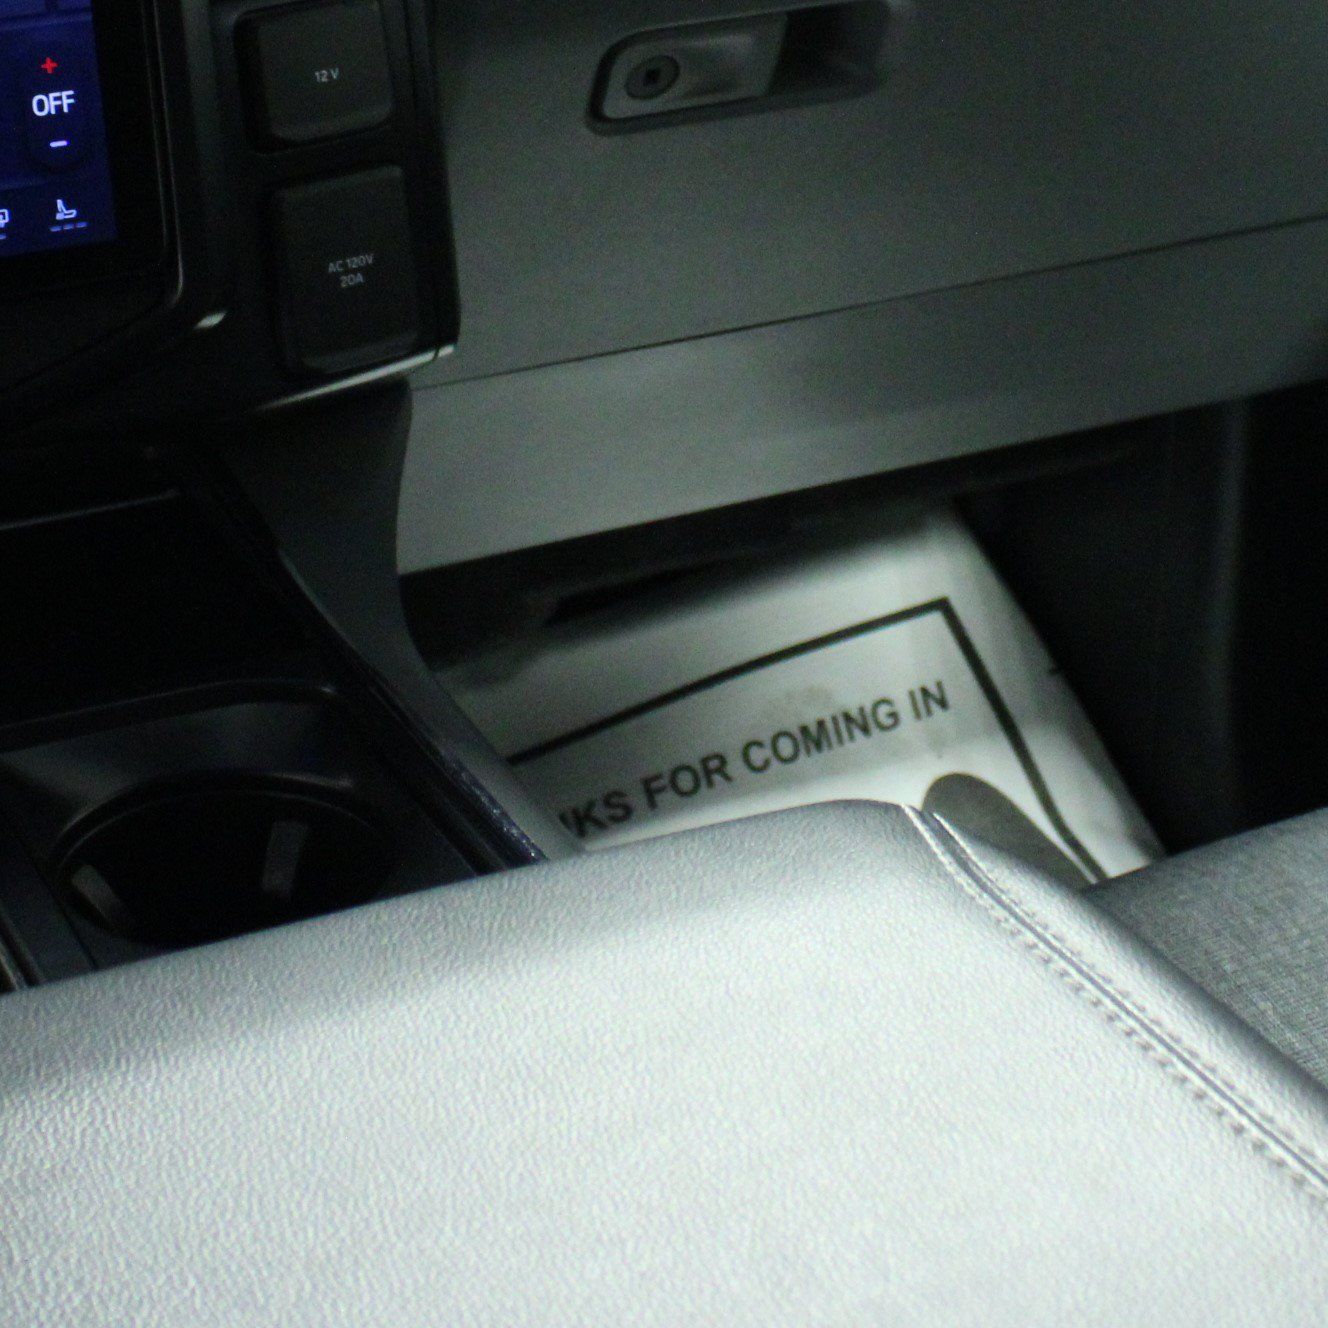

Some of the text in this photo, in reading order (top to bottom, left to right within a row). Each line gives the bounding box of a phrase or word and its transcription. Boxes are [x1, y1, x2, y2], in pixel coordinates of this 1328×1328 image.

[32, 90, 76, 118] OFF
[641, 753, 734, 810] FOR
[742, 699, 901, 773] COMING
[910, 680, 951, 718] IN
